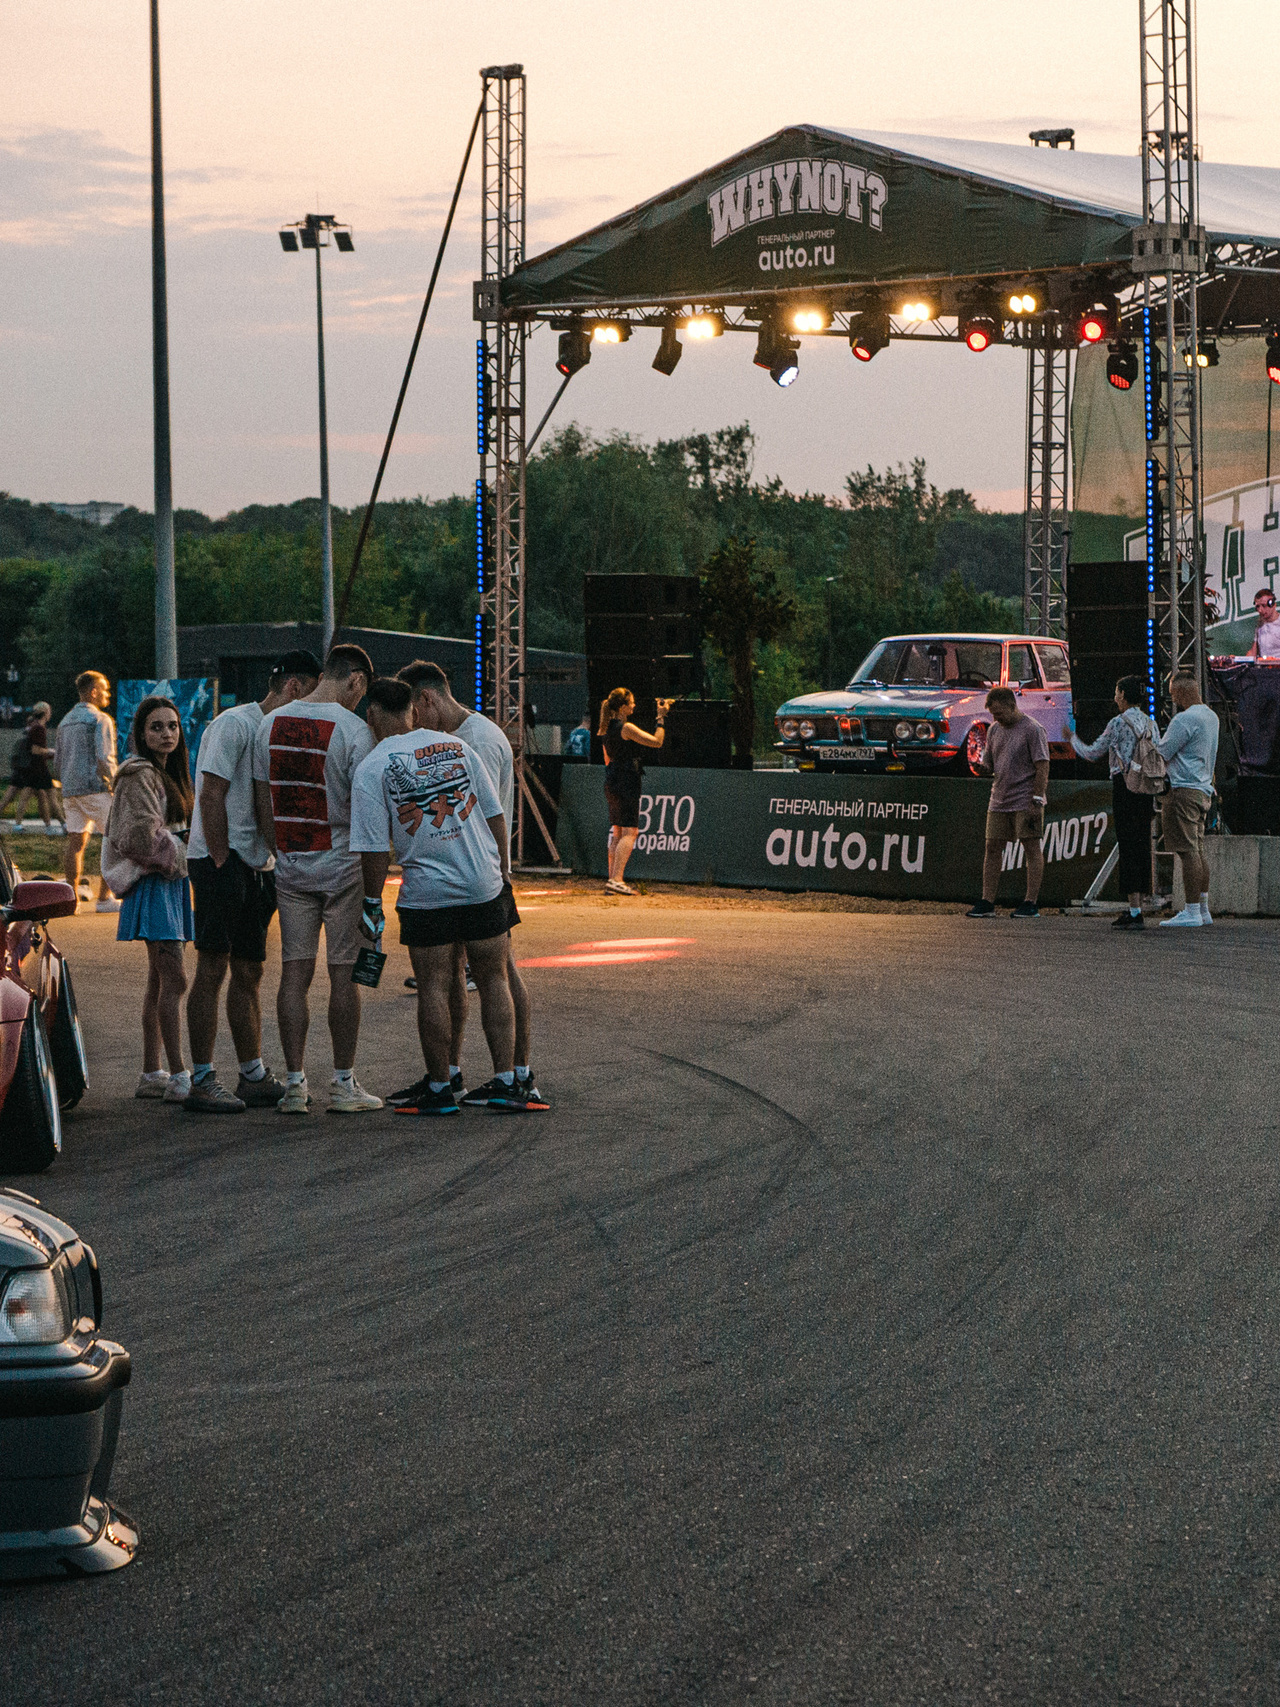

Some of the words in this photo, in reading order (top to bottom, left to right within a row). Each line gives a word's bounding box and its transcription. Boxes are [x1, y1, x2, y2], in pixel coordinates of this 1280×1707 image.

[707, 157, 888, 247] WHYNOT?
[757, 230, 804, 245] ГЕНЕРАЛЬНЫЙ
[805, 228, 835, 240] ПАРТНЕР
[758, 245, 835, 271] auto.ru
[414, 742, 463, 760] BURNS
[609, 794, 695, 835] ВТО
[769, 798, 865, 817] ГЕНЕРАЛЬНЫЙ
[867, 802, 929, 820] ПАРТНЕР
[607, 833, 691, 855] орама
[766, 823, 926, 873] auto.ru
